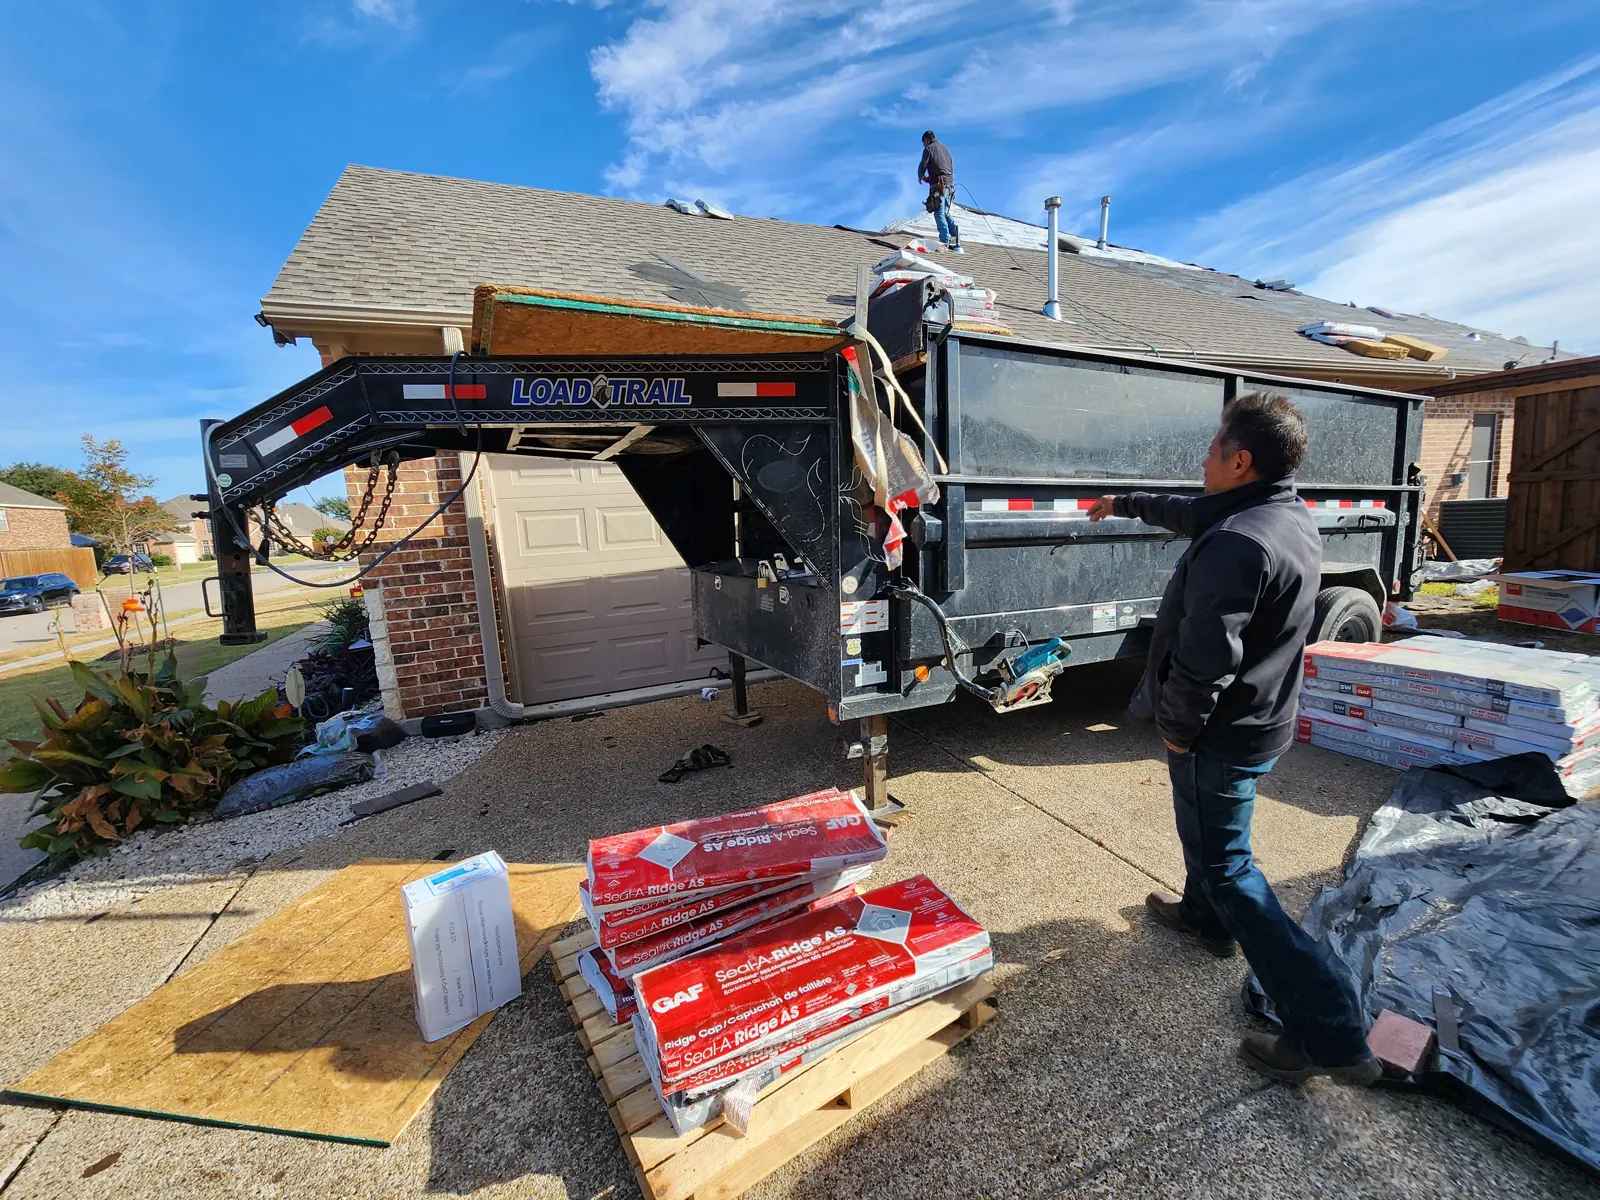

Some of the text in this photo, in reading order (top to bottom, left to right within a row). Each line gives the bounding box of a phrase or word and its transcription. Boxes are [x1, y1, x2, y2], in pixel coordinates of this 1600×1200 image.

[511, 377, 692, 406] LOAD TRAIL
[1425, 723, 1444, 734] AS
[826, 815, 862, 830] GAF
[702, 841, 726, 853] AS
[727, 826, 818, 850] Seal-A-Ridge
[604, 881, 685, 903] Seal-A-Ridge
[688, 877, 705, 888] AS
[620, 907, 697, 942] Seal-A-Ridge
[699, 900, 715, 914] AS
[633, 926, 706, 963] Seal-A-Ridge
[708, 919, 724, 933] AS
[714, 934, 823, 983] Seal-A-Ridge
[822, 924, 847, 941] AS
[652, 983, 704, 1014] GAF
[663, 1032, 697, 1053] Ridge
[782, 988, 798, 1001] de
[797, 974, 832, 995] faîtière
[667, 1060, 680, 1068] GAF
[684, 1019, 778, 1067] Seal-A-Ridge
[777, 1005, 801, 1023] AS
